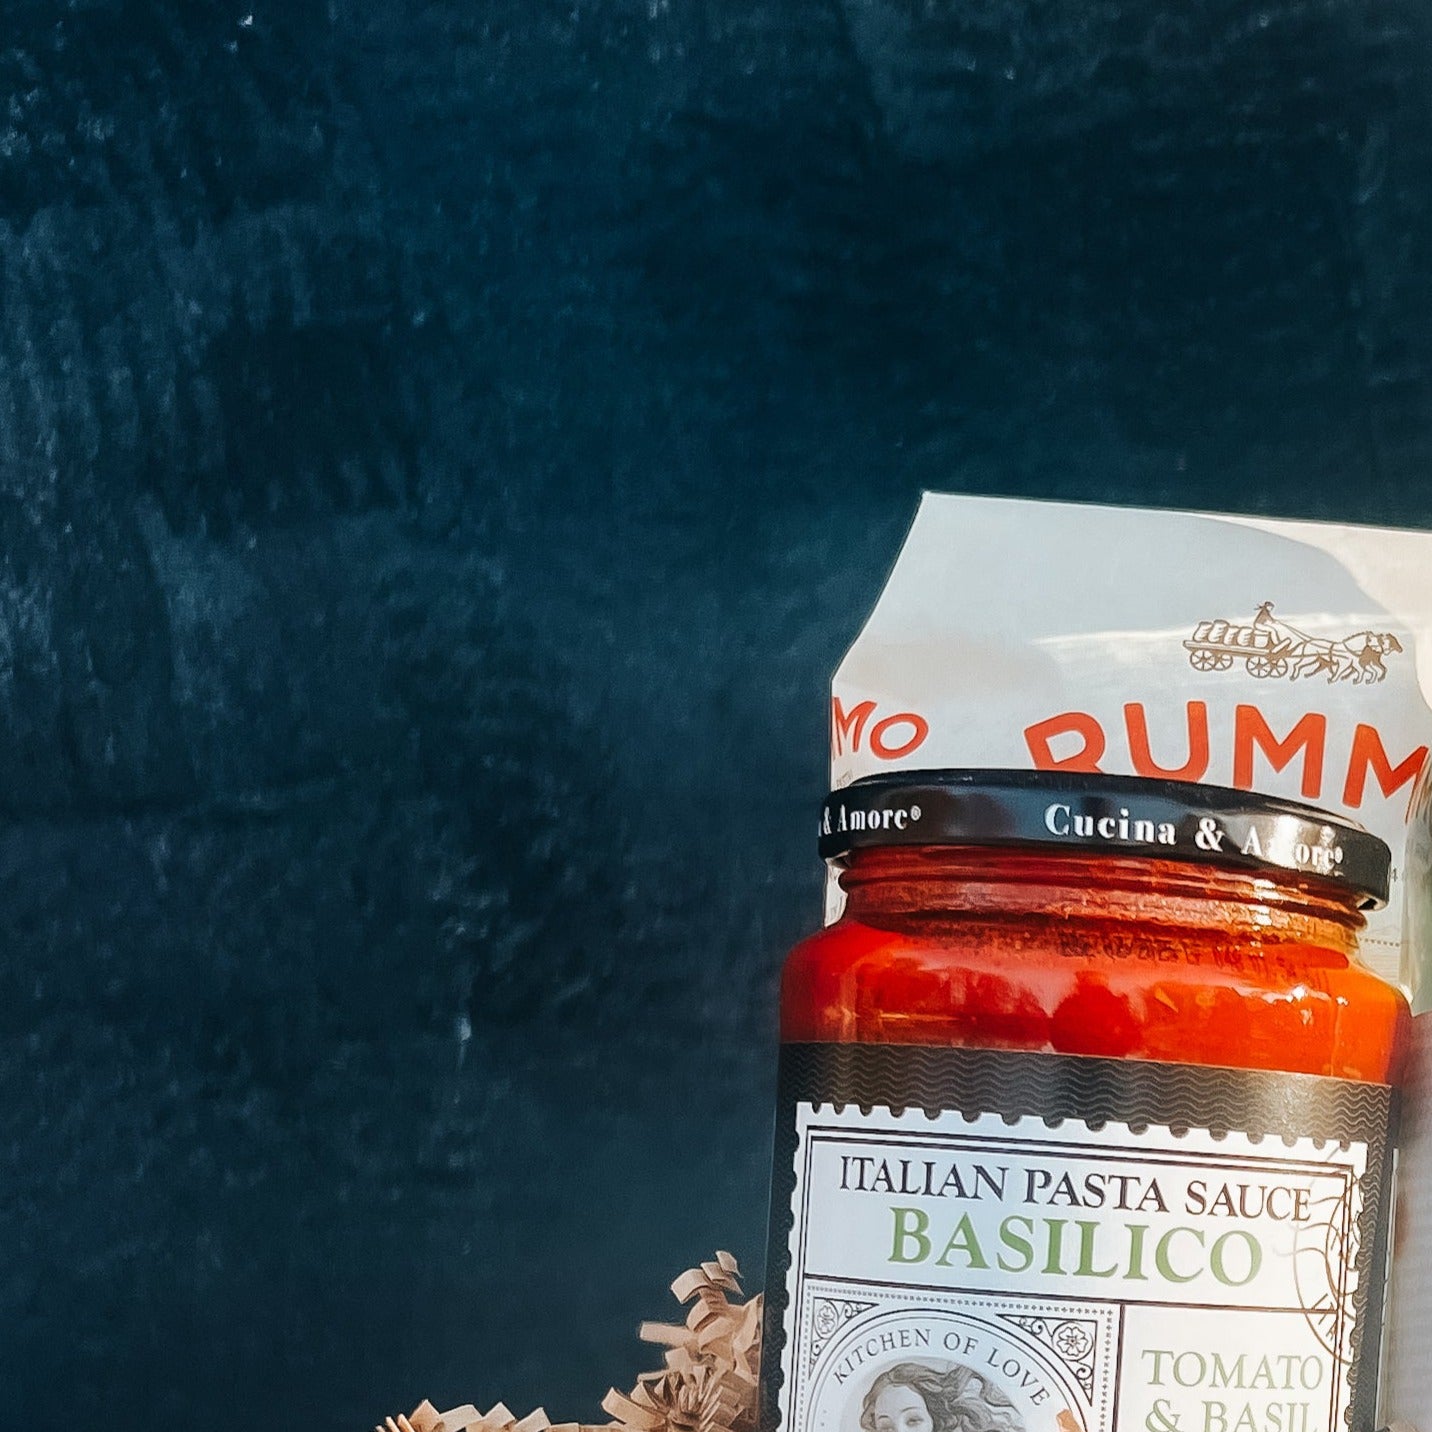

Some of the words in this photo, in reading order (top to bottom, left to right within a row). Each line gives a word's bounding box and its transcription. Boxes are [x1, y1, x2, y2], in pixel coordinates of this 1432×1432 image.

[1044, 804, 1177, 848] Cucina
[1195, 816, 1225, 853] &
[1241, 825, 1344, 870] Aore®
[840, 1155, 1006, 1200] ITALIAN
[1023, 1168, 1169, 1214] PASTA
[1185, 1180, 1312, 1223] SAUCE
[887, 1207, 1264, 1287] BASILICO
[834, 1328, 931, 1385] KITCHEN
[943, 1332, 979, 1355] OF
[987, 1347, 1051, 1406] LOVE
[1141, 1349, 1323, 1392] TOMATO
